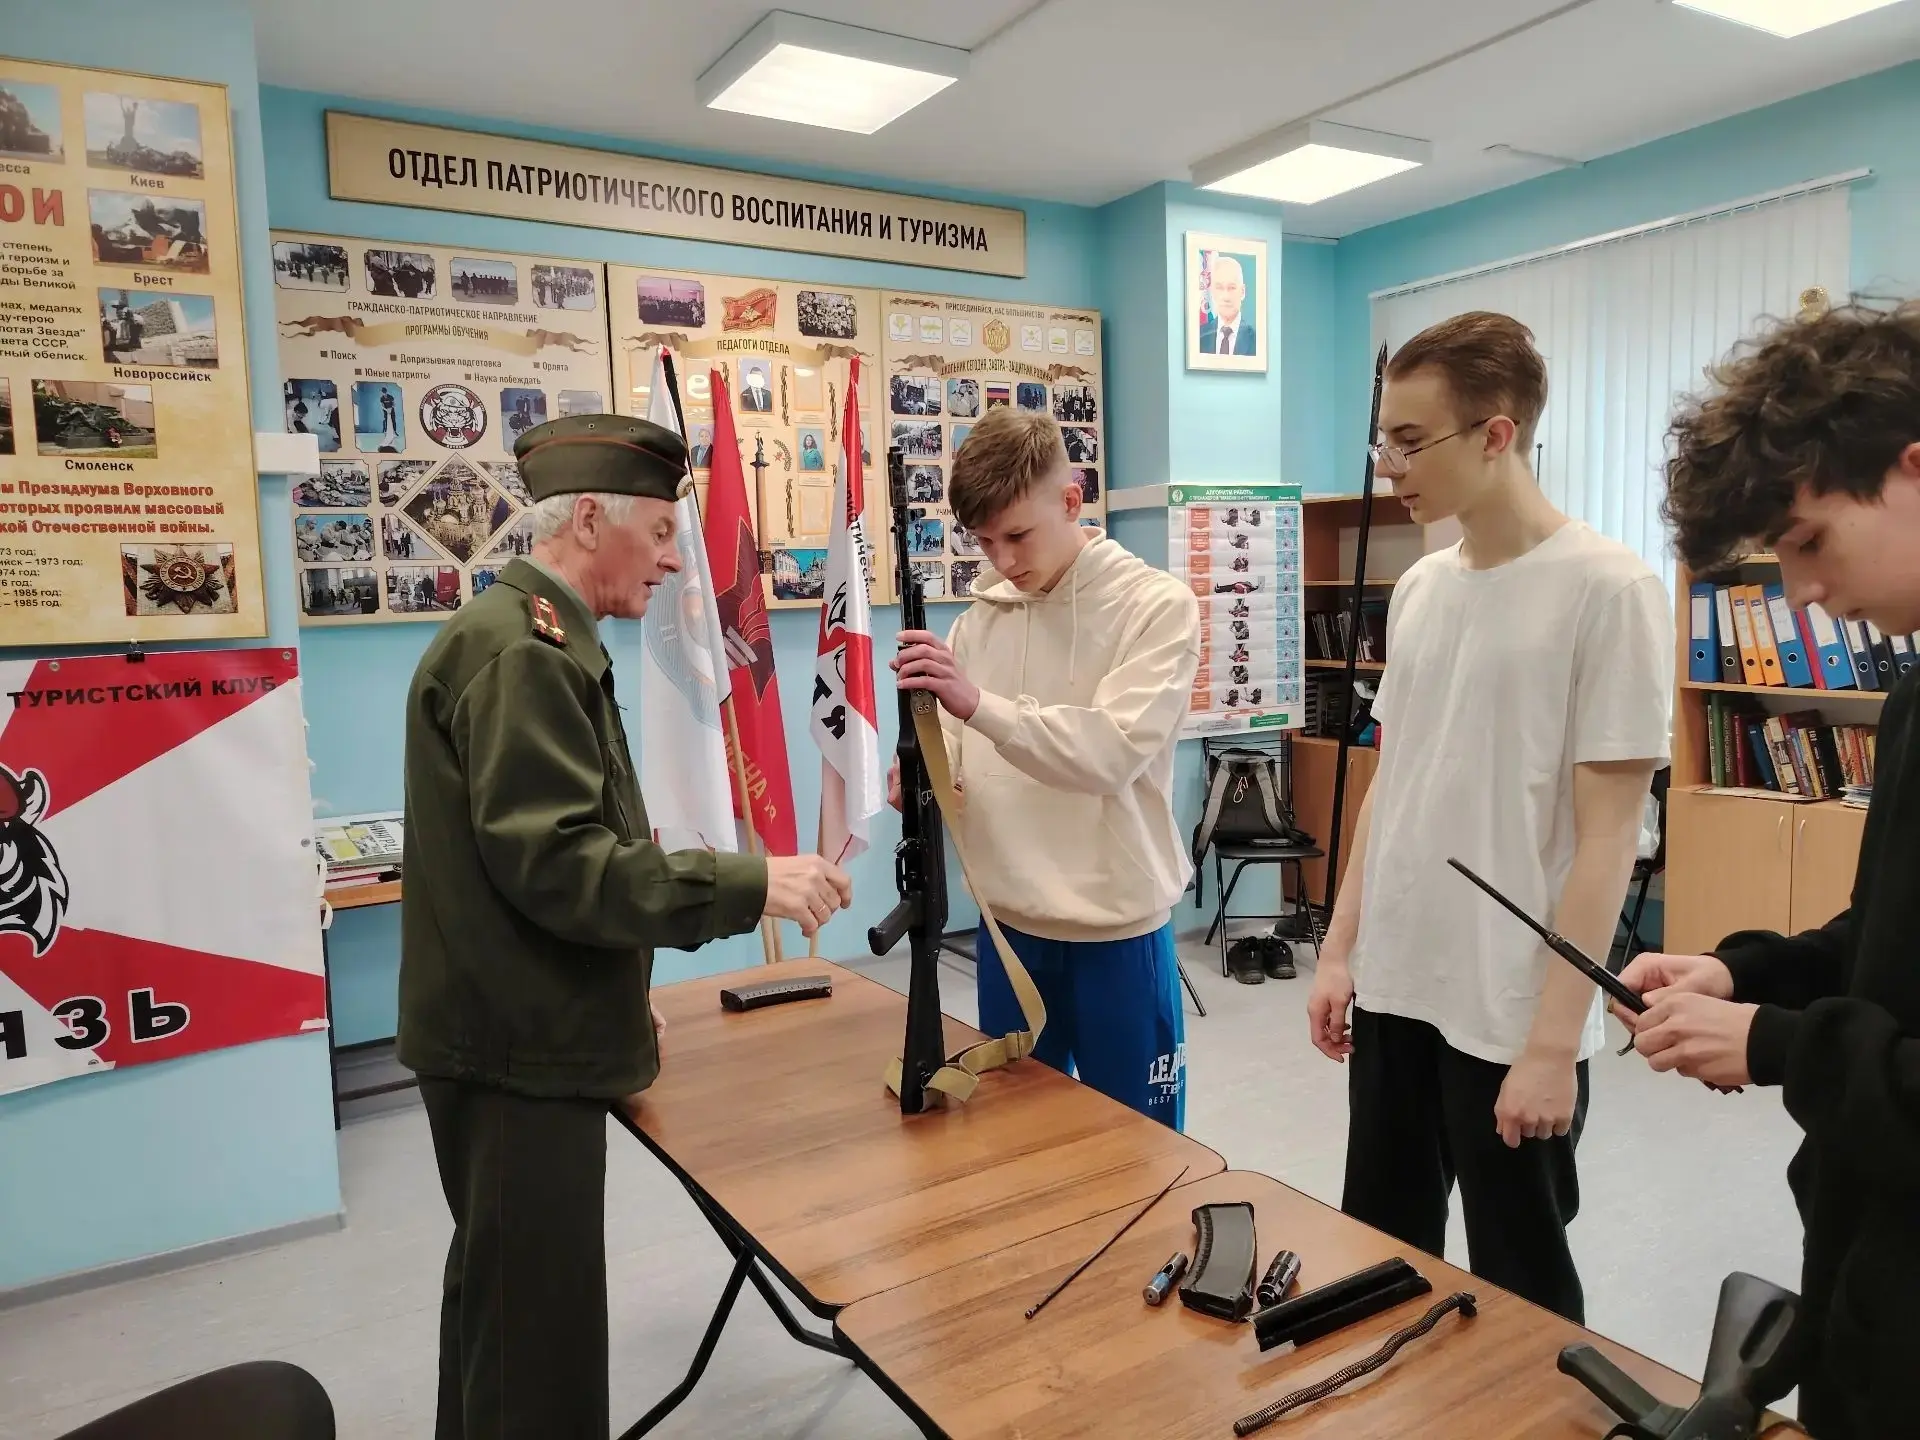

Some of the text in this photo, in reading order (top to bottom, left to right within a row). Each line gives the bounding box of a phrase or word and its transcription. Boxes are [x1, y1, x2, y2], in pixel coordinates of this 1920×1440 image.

[130, 175, 165, 190] Киев
[388, 148, 989, 252] ОТДЕЛ ПАТРИОТИЧЕСКОГО ВОСПИТАНИЯ И ТУРИЗМА
[3, 241, 53, 253] степень
[9, 254, 59, 266] героизм
[63, 258, 70, 266] и
[2, 264, 64, 278] борьбе за
[23, 277, 76, 290] Великой
[133, 273, 174, 287] Брест
[29, 303, 82, 314] медалях
[347, 301, 538, 324] ГРАЖДАНСКО-ПАТРИОТИЧЕСКОЕ НАПРАВЛЕНИЕ
[405, 324, 489, 341] ПРОГРАММЫ ОБУЧЕНИЯ
[32, 337, 69, 349] СССР.
[717, 338, 790, 356] ПЕДАГОГИ ОТДЕЛА
[34, 349, 88, 361] обелиск.
[331, 349, 357, 361] Поиск
[400, 353, 502, 369] Допризывная подготовка
[542, 360, 569, 373] Орлята
[113, 367, 212, 383] Новороссийск
[364, 367, 431, 382] Юные патриоты
[474, 373, 541, 387] Наука побеждать
[65, 459, 134, 473] Смоленск
[18, 480, 120, 498] Президиума
[123, 482, 214, 497] Верховного
[64, 503, 141, 516] проявили
[145, 501, 225, 515] массовый
[32, 519, 156, 534] Отечественной
[159, 520, 215, 534] войны.
[15, 548, 37, 557] год;
[35, 558, 60, 566] 1973
[62, 558, 84, 567] год;
[19, 569, 40, 578] год;
[11, 580, 33, 588] год;
[14, 589, 38, 597] 1985
[14, 599, 38, 607] 1985
[41, 599, 62, 608] год.
[6, 675, 278, 710] ТУРИСТСКИЙ КЛУБ
[1148, 1096, 1171, 1106] BEST
